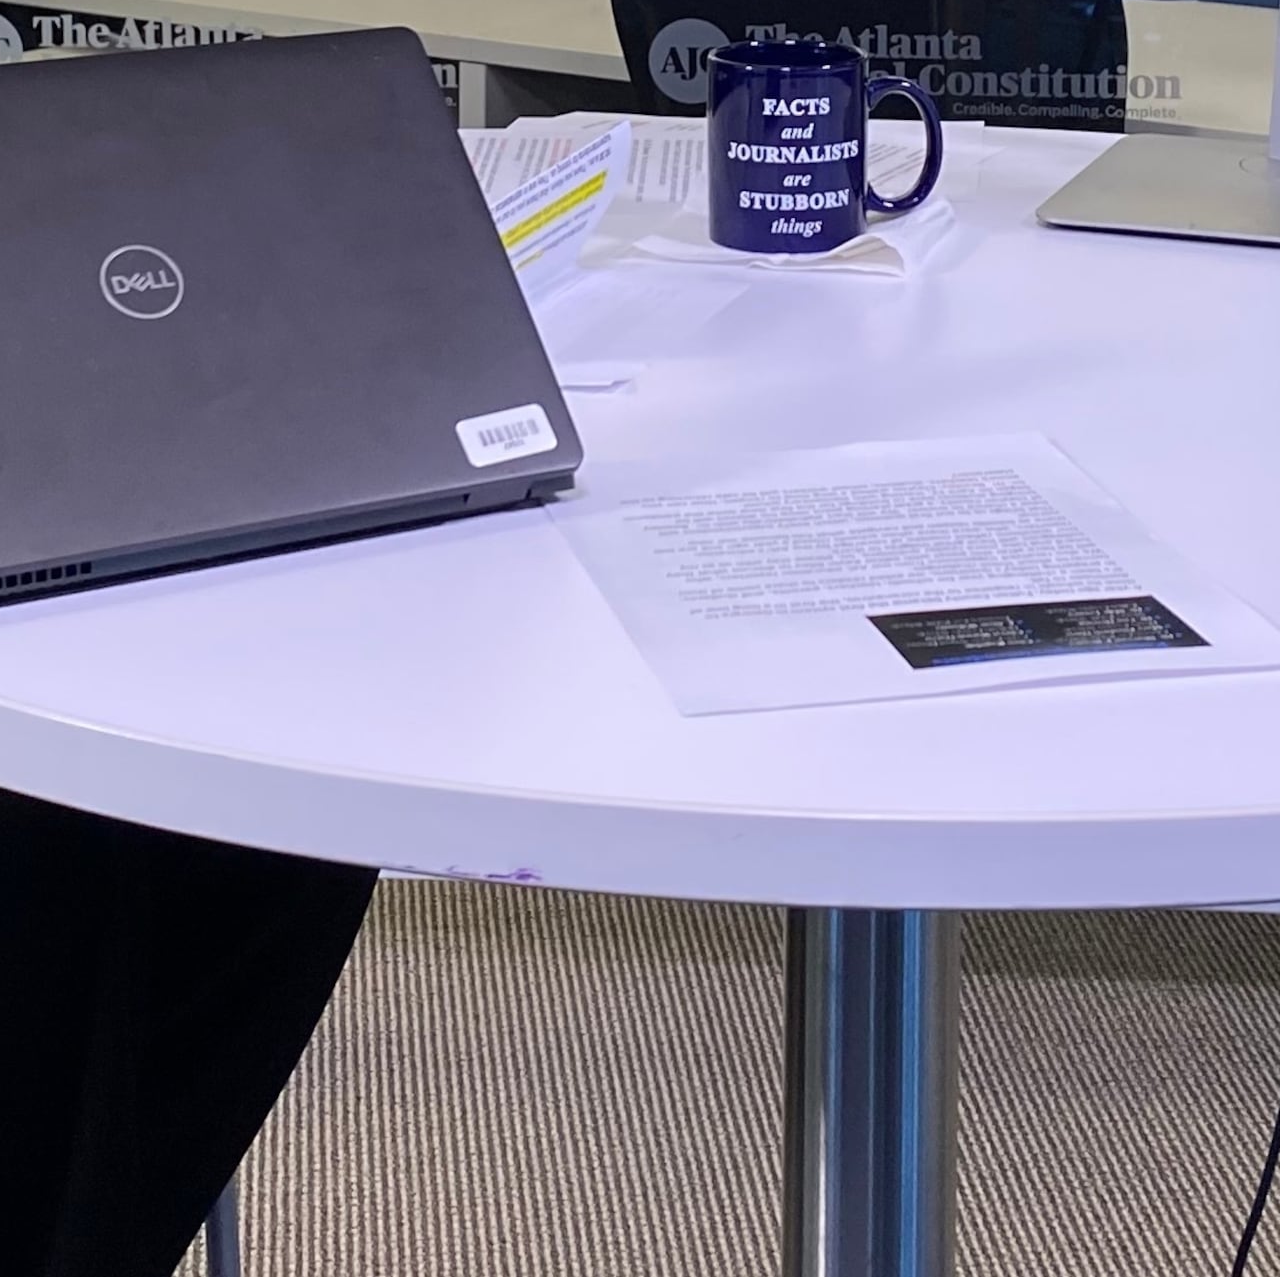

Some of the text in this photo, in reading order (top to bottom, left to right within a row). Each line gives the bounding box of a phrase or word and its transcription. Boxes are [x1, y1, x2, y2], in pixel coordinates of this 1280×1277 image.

[32, 14, 110, 48] The
[762, 97, 830, 117] FACTS
[953, 102, 1016, 118] Credible.
[1018, 103, 1104, 120] Compelling.
[781, 122, 814, 140] and
[727, 139, 859, 165] JOURNALISTS
[783, 173, 812, 187] are
[739, 188, 850, 211] STUBBORN
[771, 217, 823, 238] things
[110, 270, 177, 295] DELL
